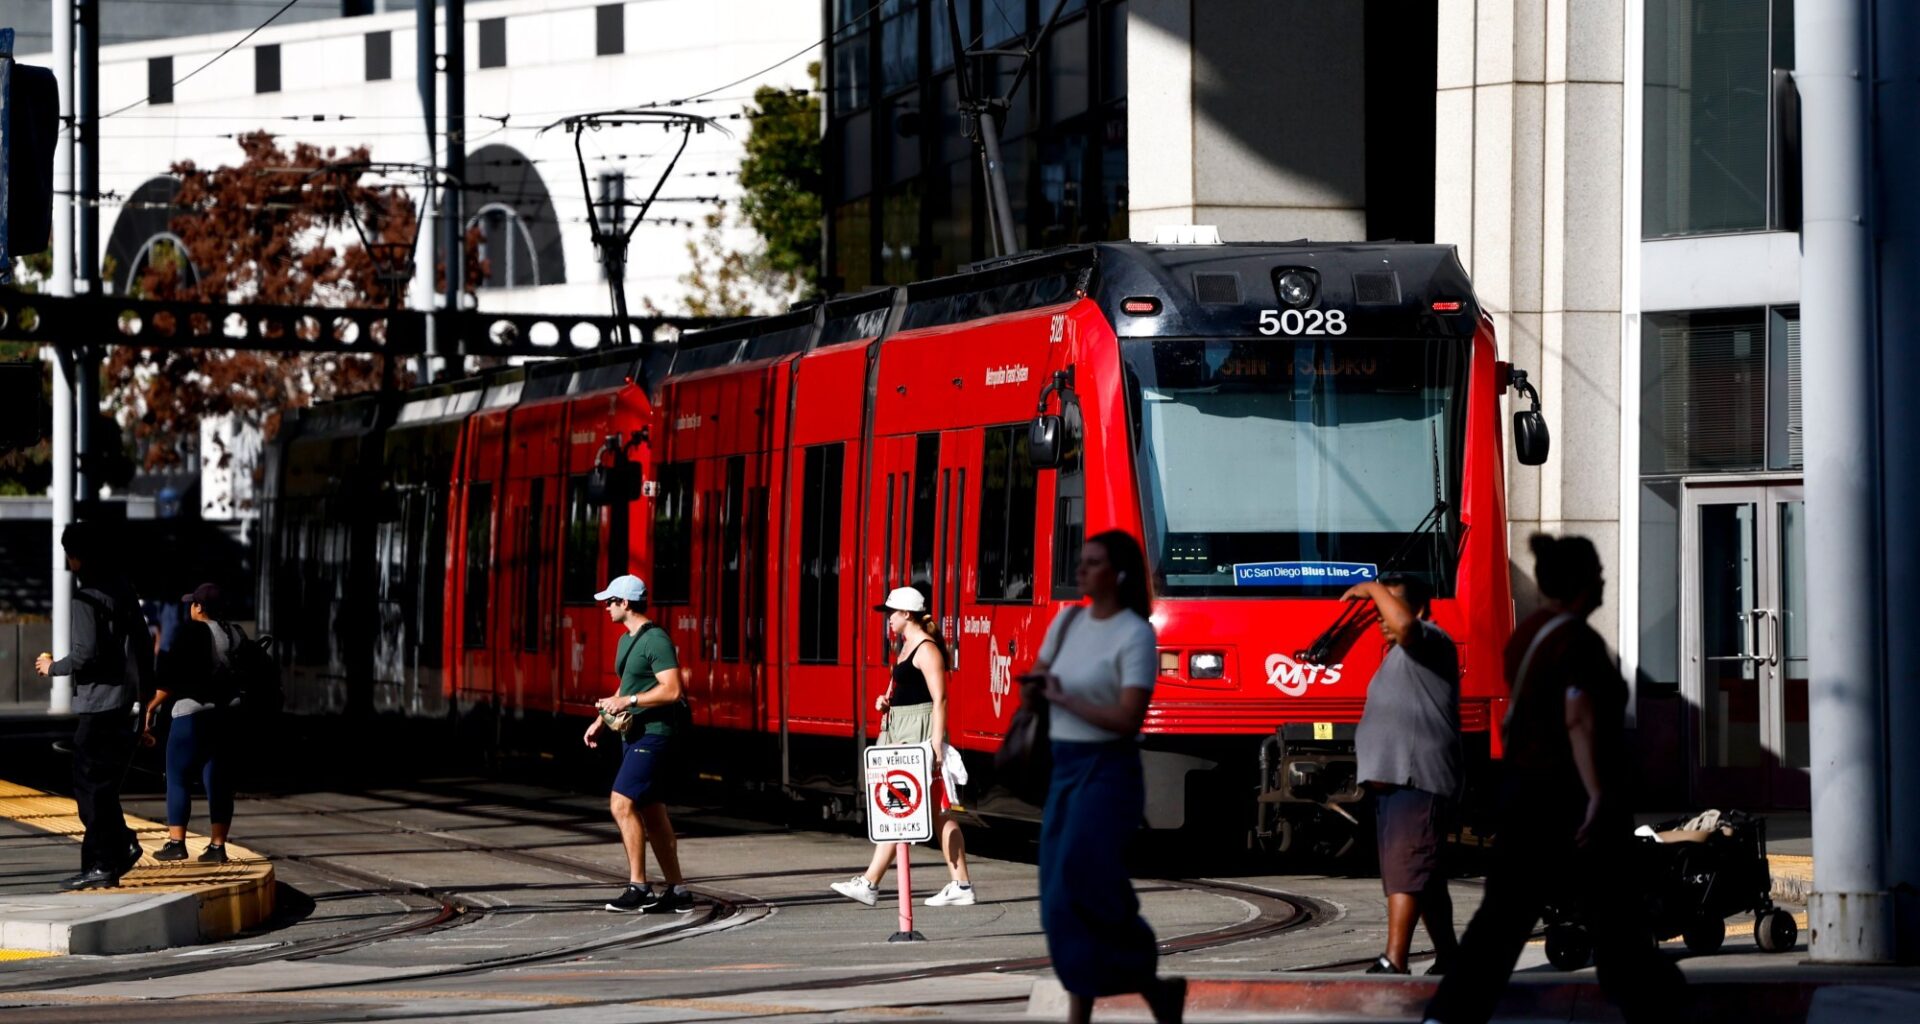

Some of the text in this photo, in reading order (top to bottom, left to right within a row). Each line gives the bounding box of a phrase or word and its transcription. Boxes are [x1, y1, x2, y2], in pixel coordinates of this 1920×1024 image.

[1258, 309, 1347, 335] 5028
[1240, 566, 1350, 579] UC San Diego Blue Line
[1266, 662, 1344, 686] MTS
[872, 755, 920, 766] NO VEHICLES
[880, 822, 920, 833] ON TRACKS
